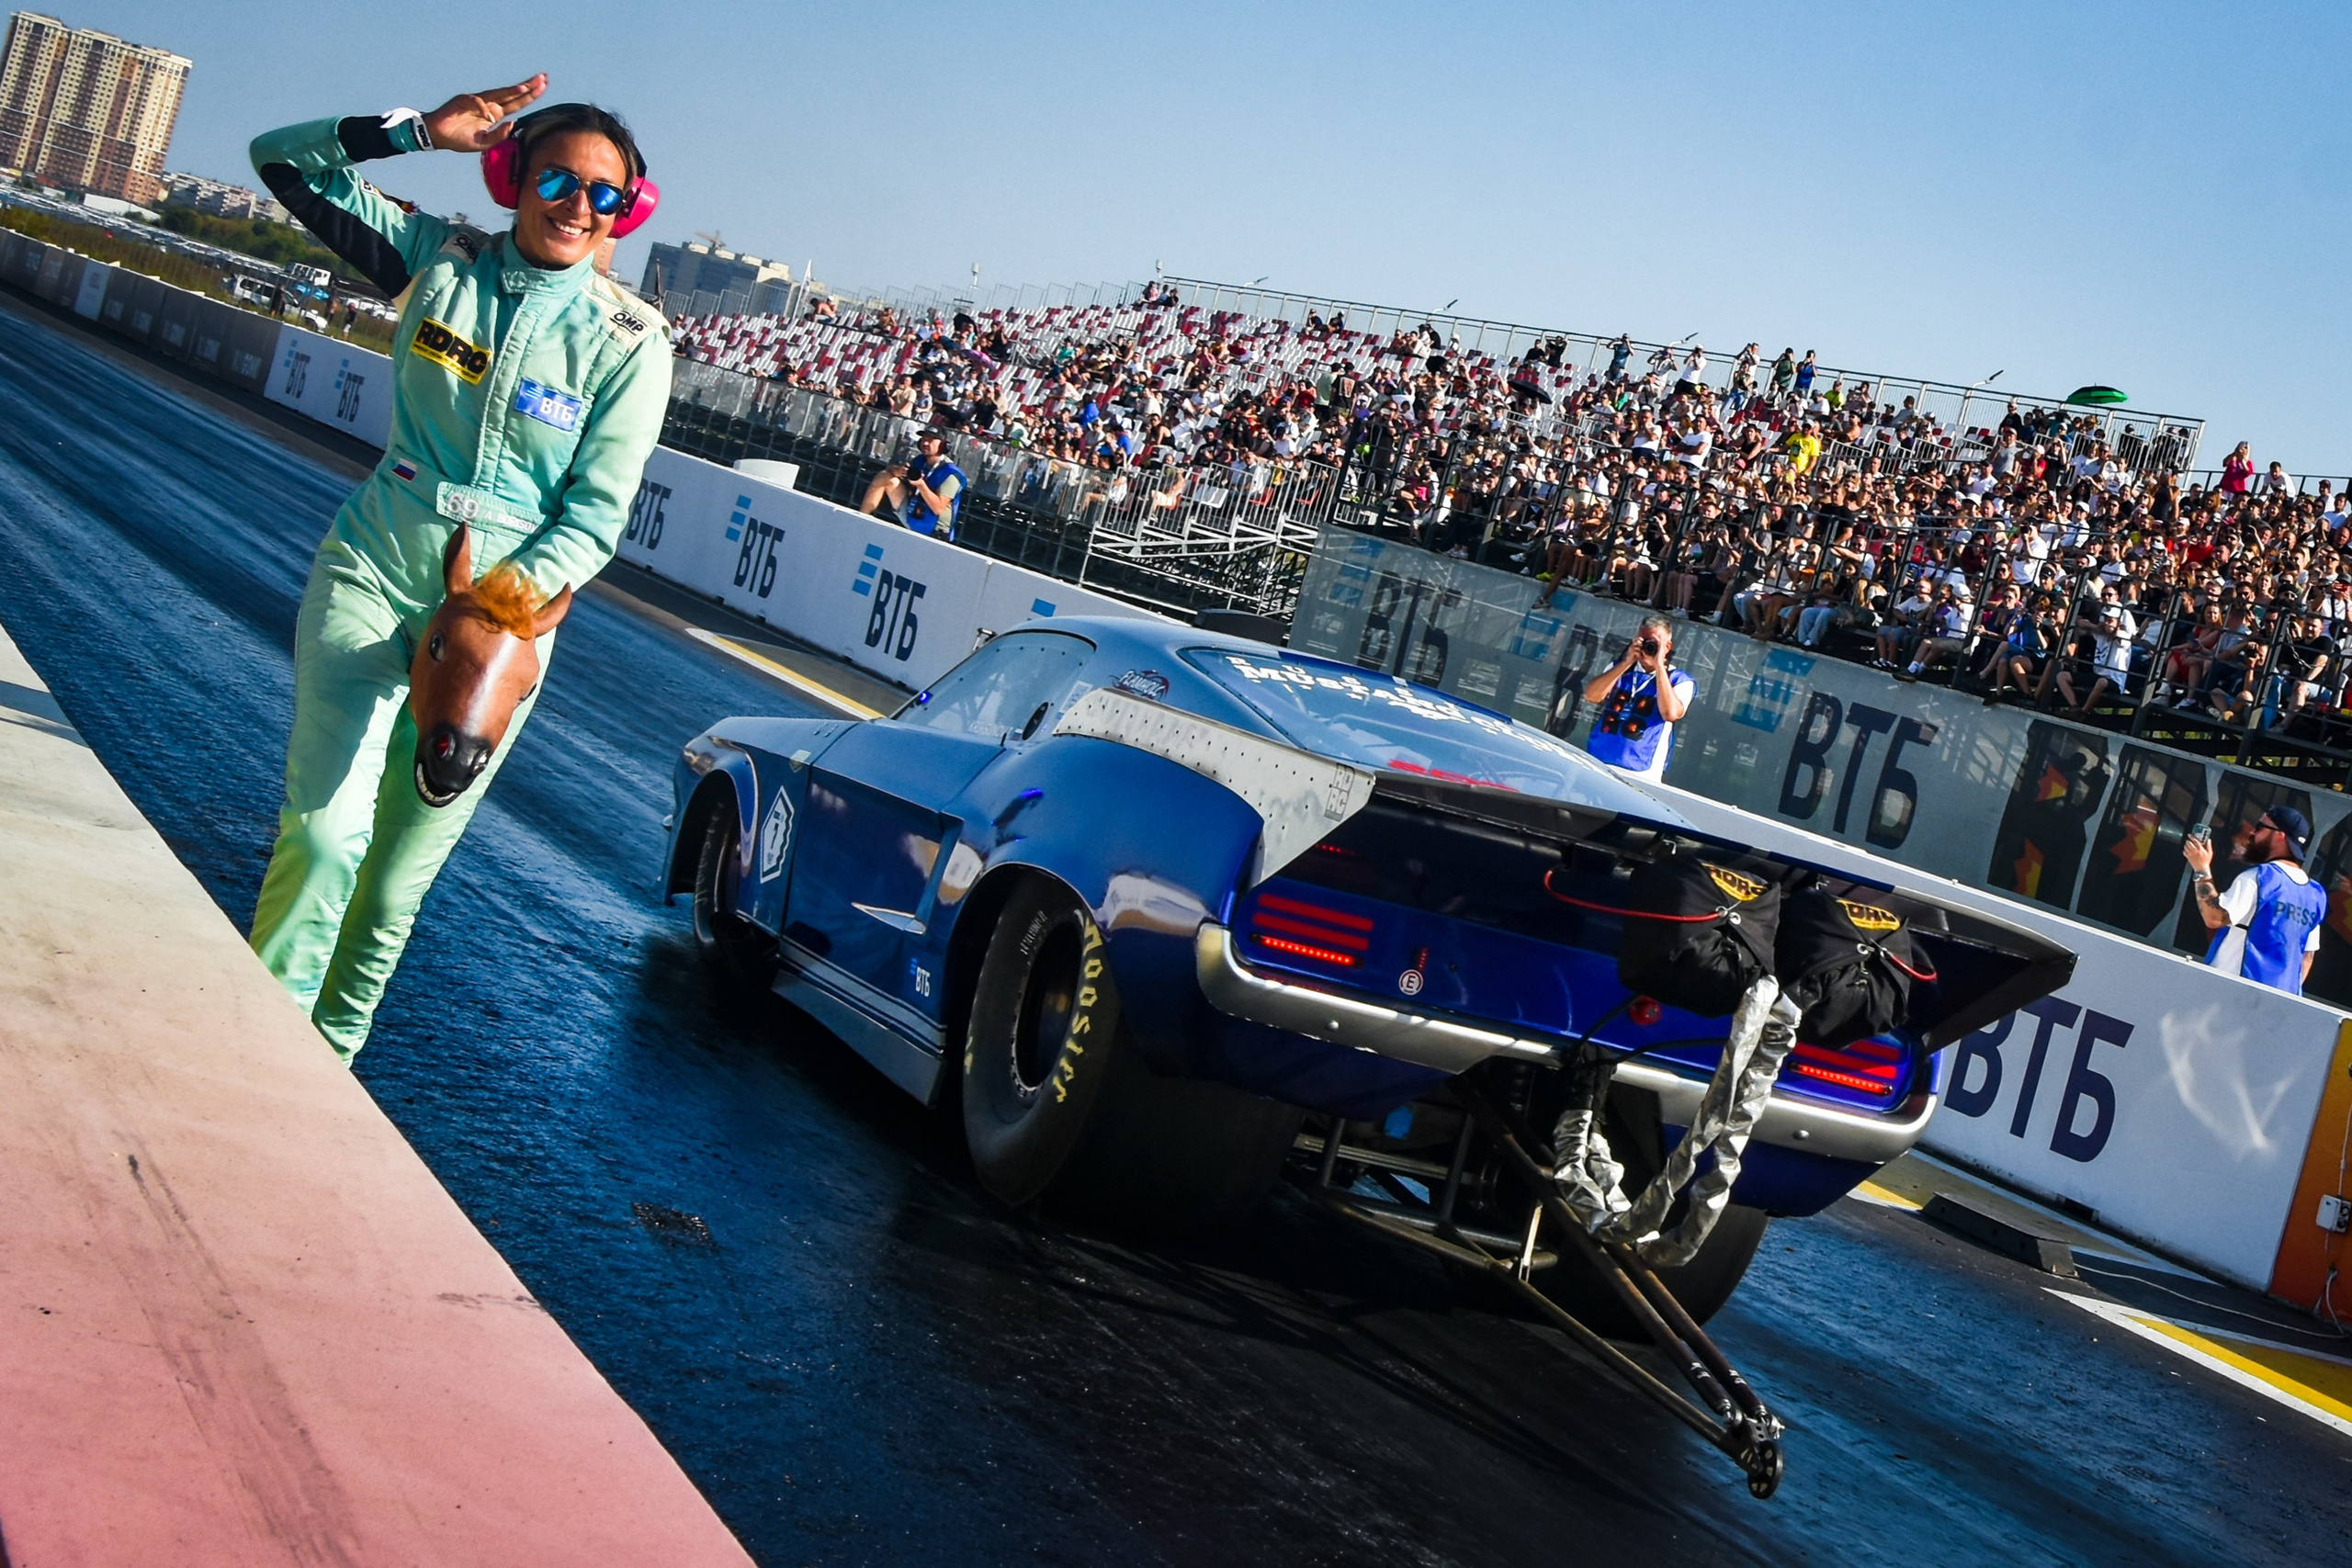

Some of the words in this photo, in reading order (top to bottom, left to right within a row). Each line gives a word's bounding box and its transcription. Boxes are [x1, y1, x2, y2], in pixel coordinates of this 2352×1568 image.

[415, 320, 488, 375] RDRC
[613, 312, 644, 332] OMP
[285, 351, 311, 399] ВТБ
[337, 372, 365, 423] ВТБ
[539, 396, 575, 422] ВТБ
[446, 492, 479, 519] 69
[626, 478, 673, 550] ВТБ
[733, 517, 786, 599] ВТБ
[865, 569, 927, 662] ВТБ
[1356, 570, 1463, 689] ВТБ
[1778, 691, 1939, 850] ВТБ
[2274, 900, 2317, 928] PRESS
[915, 966, 931, 998] ВТБ
[1944, 994, 2134, 1163] ВТБ
